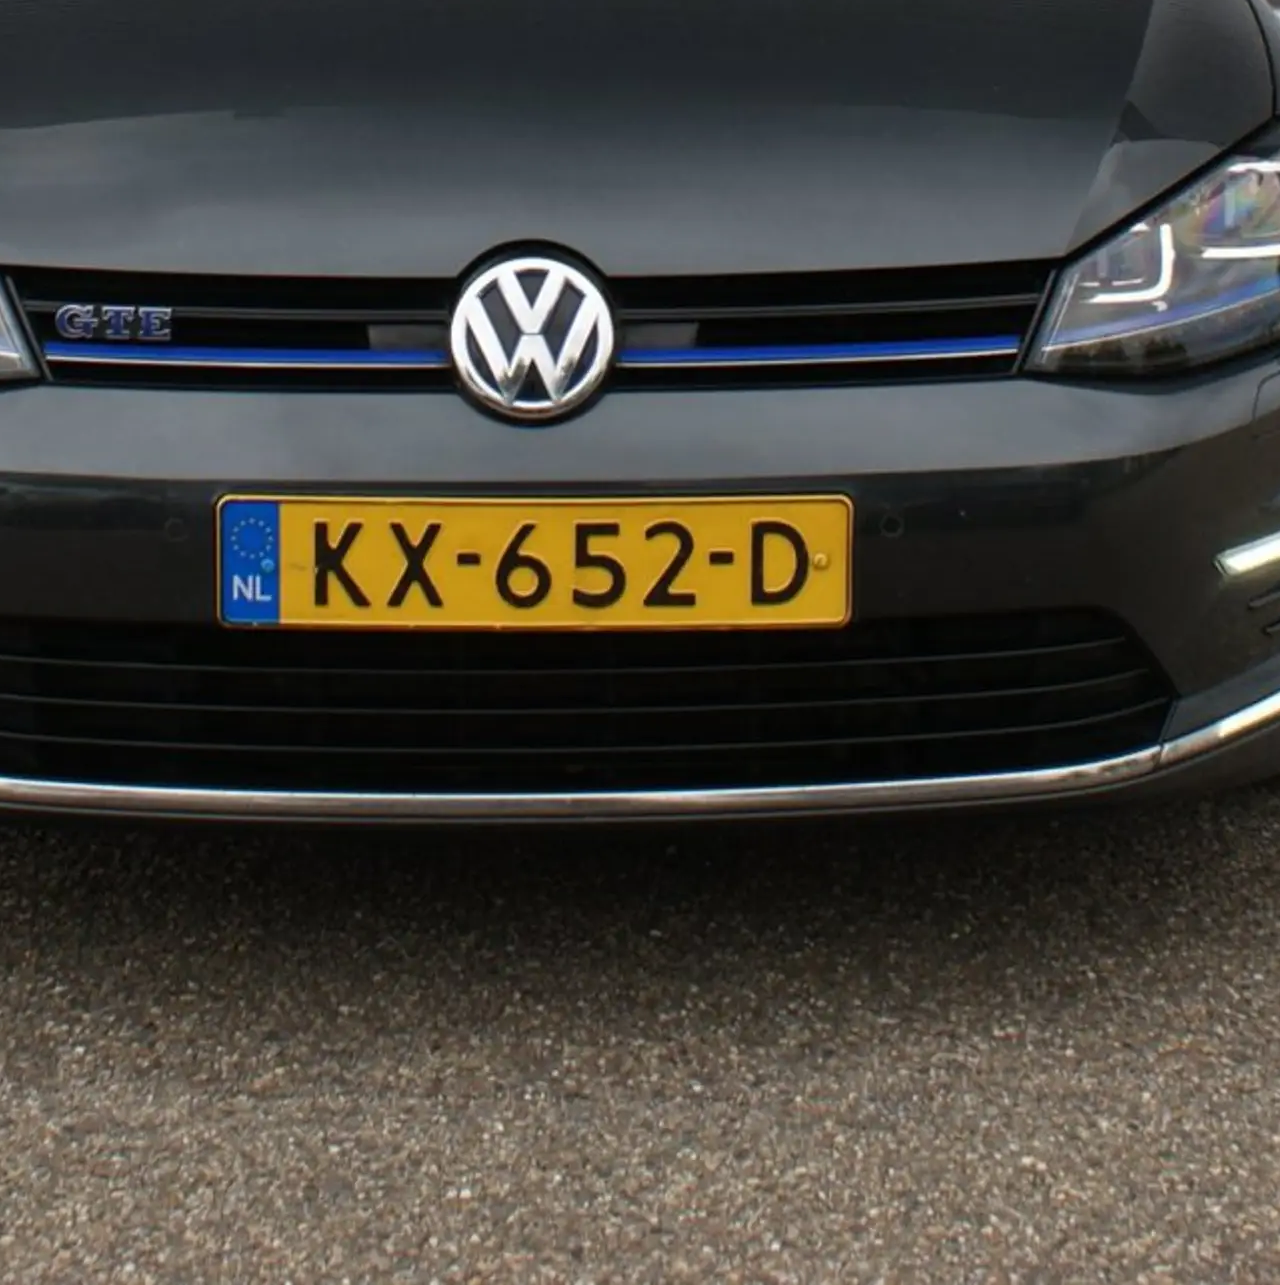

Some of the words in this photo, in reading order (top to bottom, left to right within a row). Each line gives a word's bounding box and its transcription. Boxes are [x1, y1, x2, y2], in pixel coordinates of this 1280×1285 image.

[55, 304, 172, 341] GTE
[313, 520, 810, 609] KX-652-D
[232, 574, 272, 602] NL
